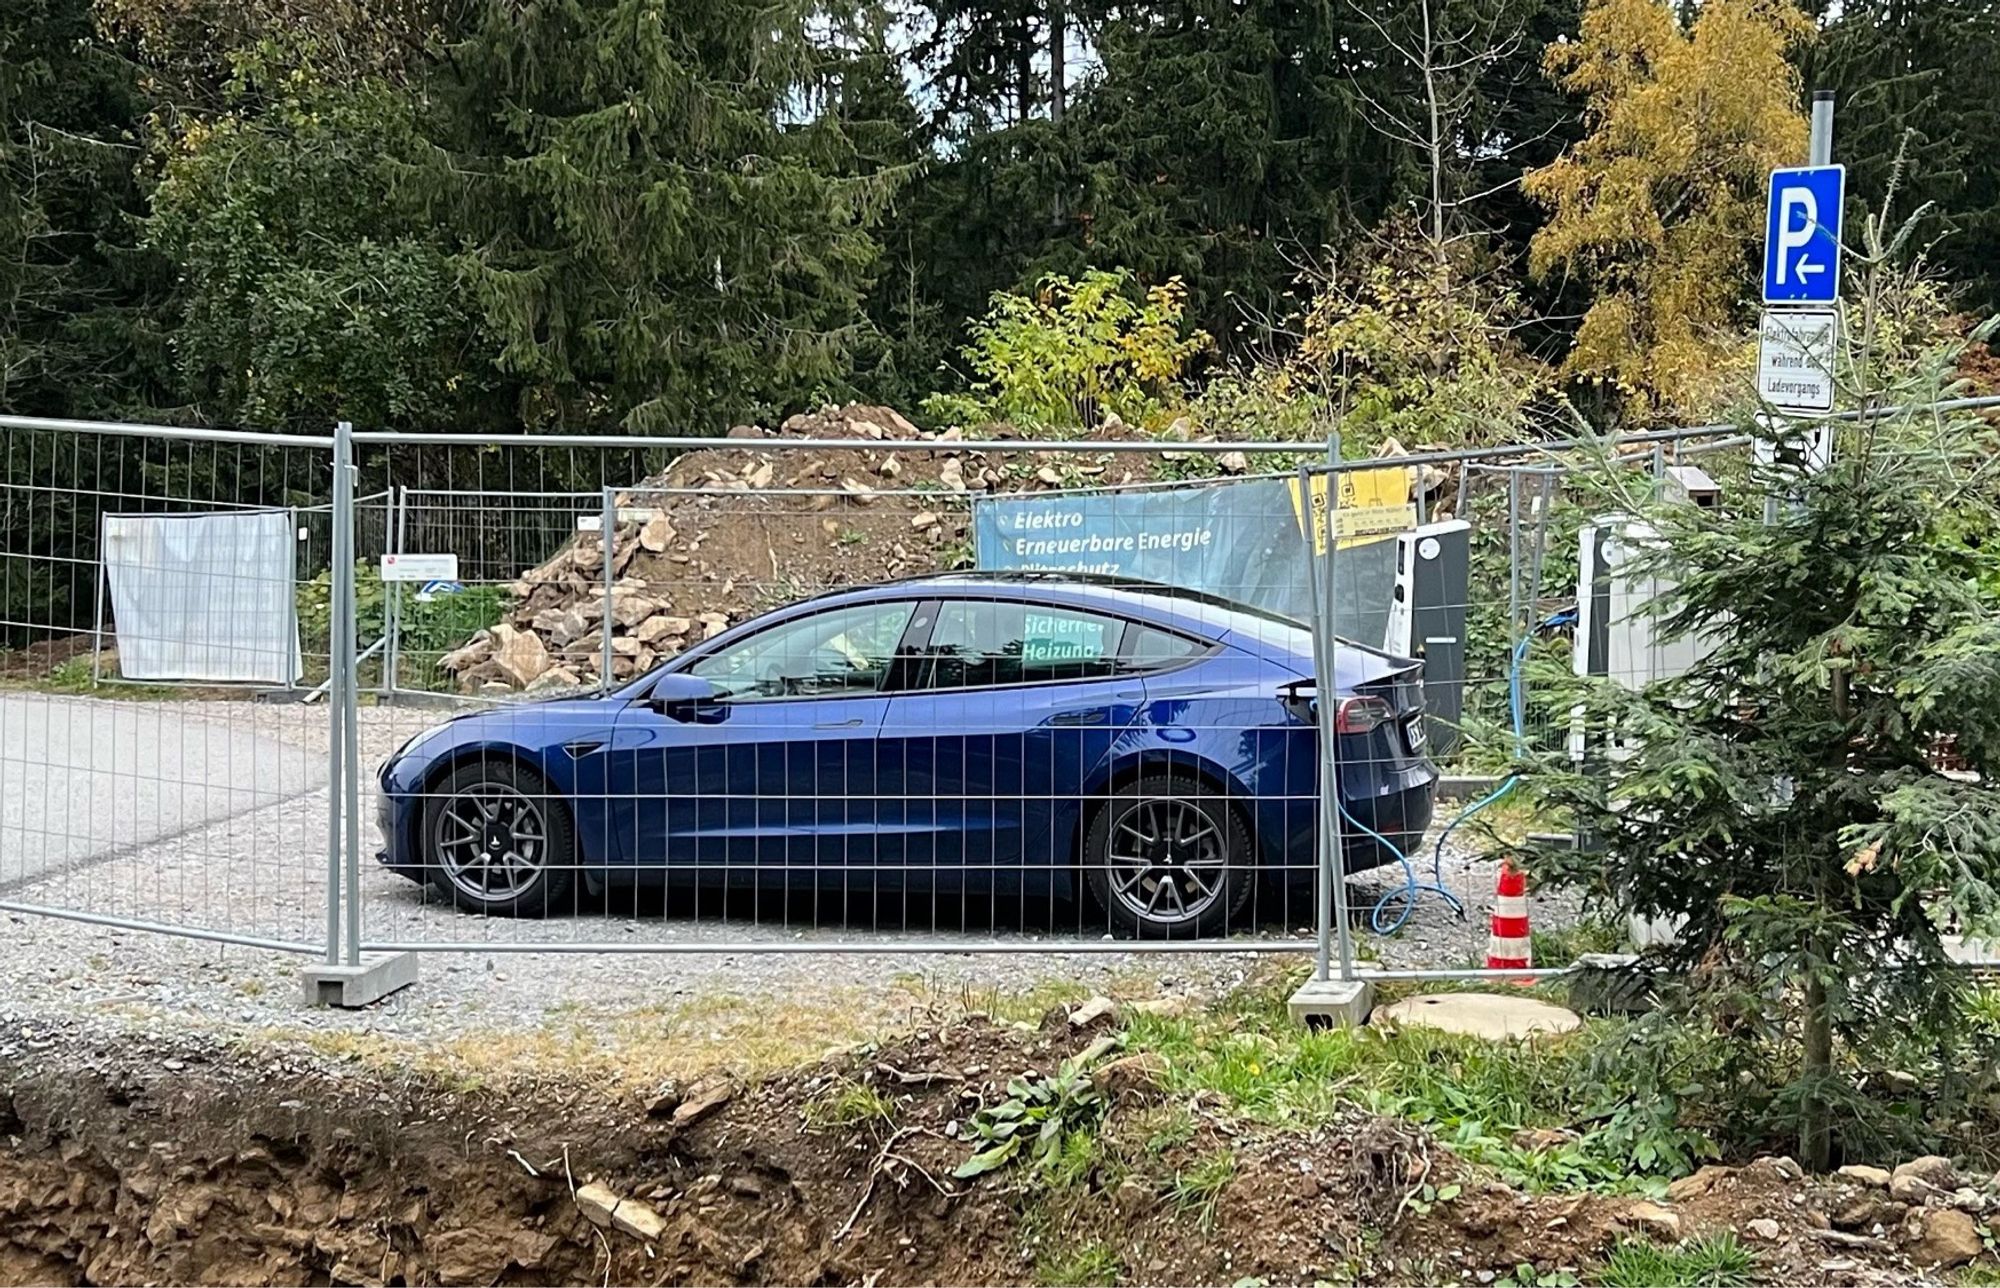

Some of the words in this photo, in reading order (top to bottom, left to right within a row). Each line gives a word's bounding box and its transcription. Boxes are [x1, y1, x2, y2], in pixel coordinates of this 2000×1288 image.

[1776, 186, 1818, 286] P
[1771, 353, 1803, 369] während
[1768, 377, 1821, 399] Ladevorgangs
[1014, 510, 1083, 529] Elektro
[1016, 534, 1134, 556] Erneuerbare
[1138, 527, 1212, 552] Energie
